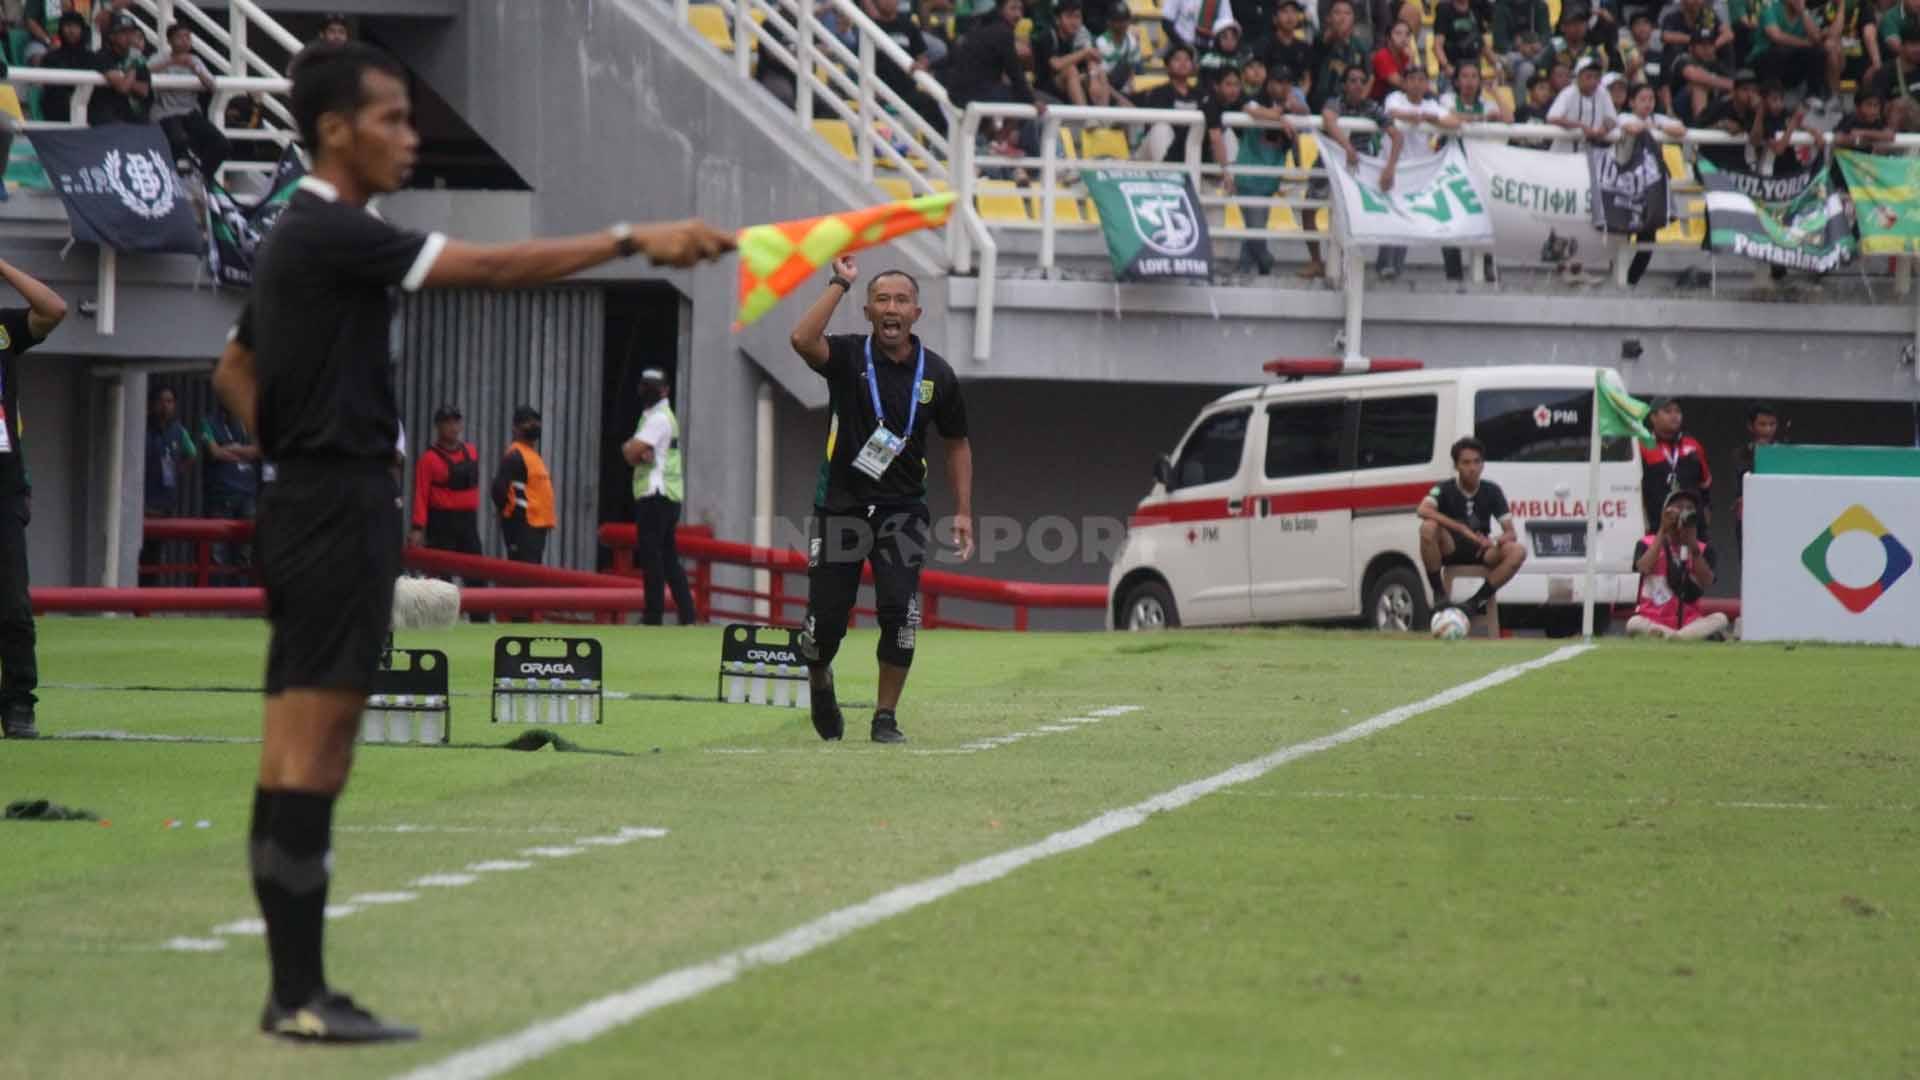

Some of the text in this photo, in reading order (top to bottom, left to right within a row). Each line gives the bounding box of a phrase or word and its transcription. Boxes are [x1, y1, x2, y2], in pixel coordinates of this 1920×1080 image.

[1138, 259, 1171, 274] LOVE
[1553, 410, 1578, 424] PMI
[1510, 501, 1627, 517] MBULACE
[747, 650, 797, 662] ORAGA
[520, 663, 575, 675] ORAGA
